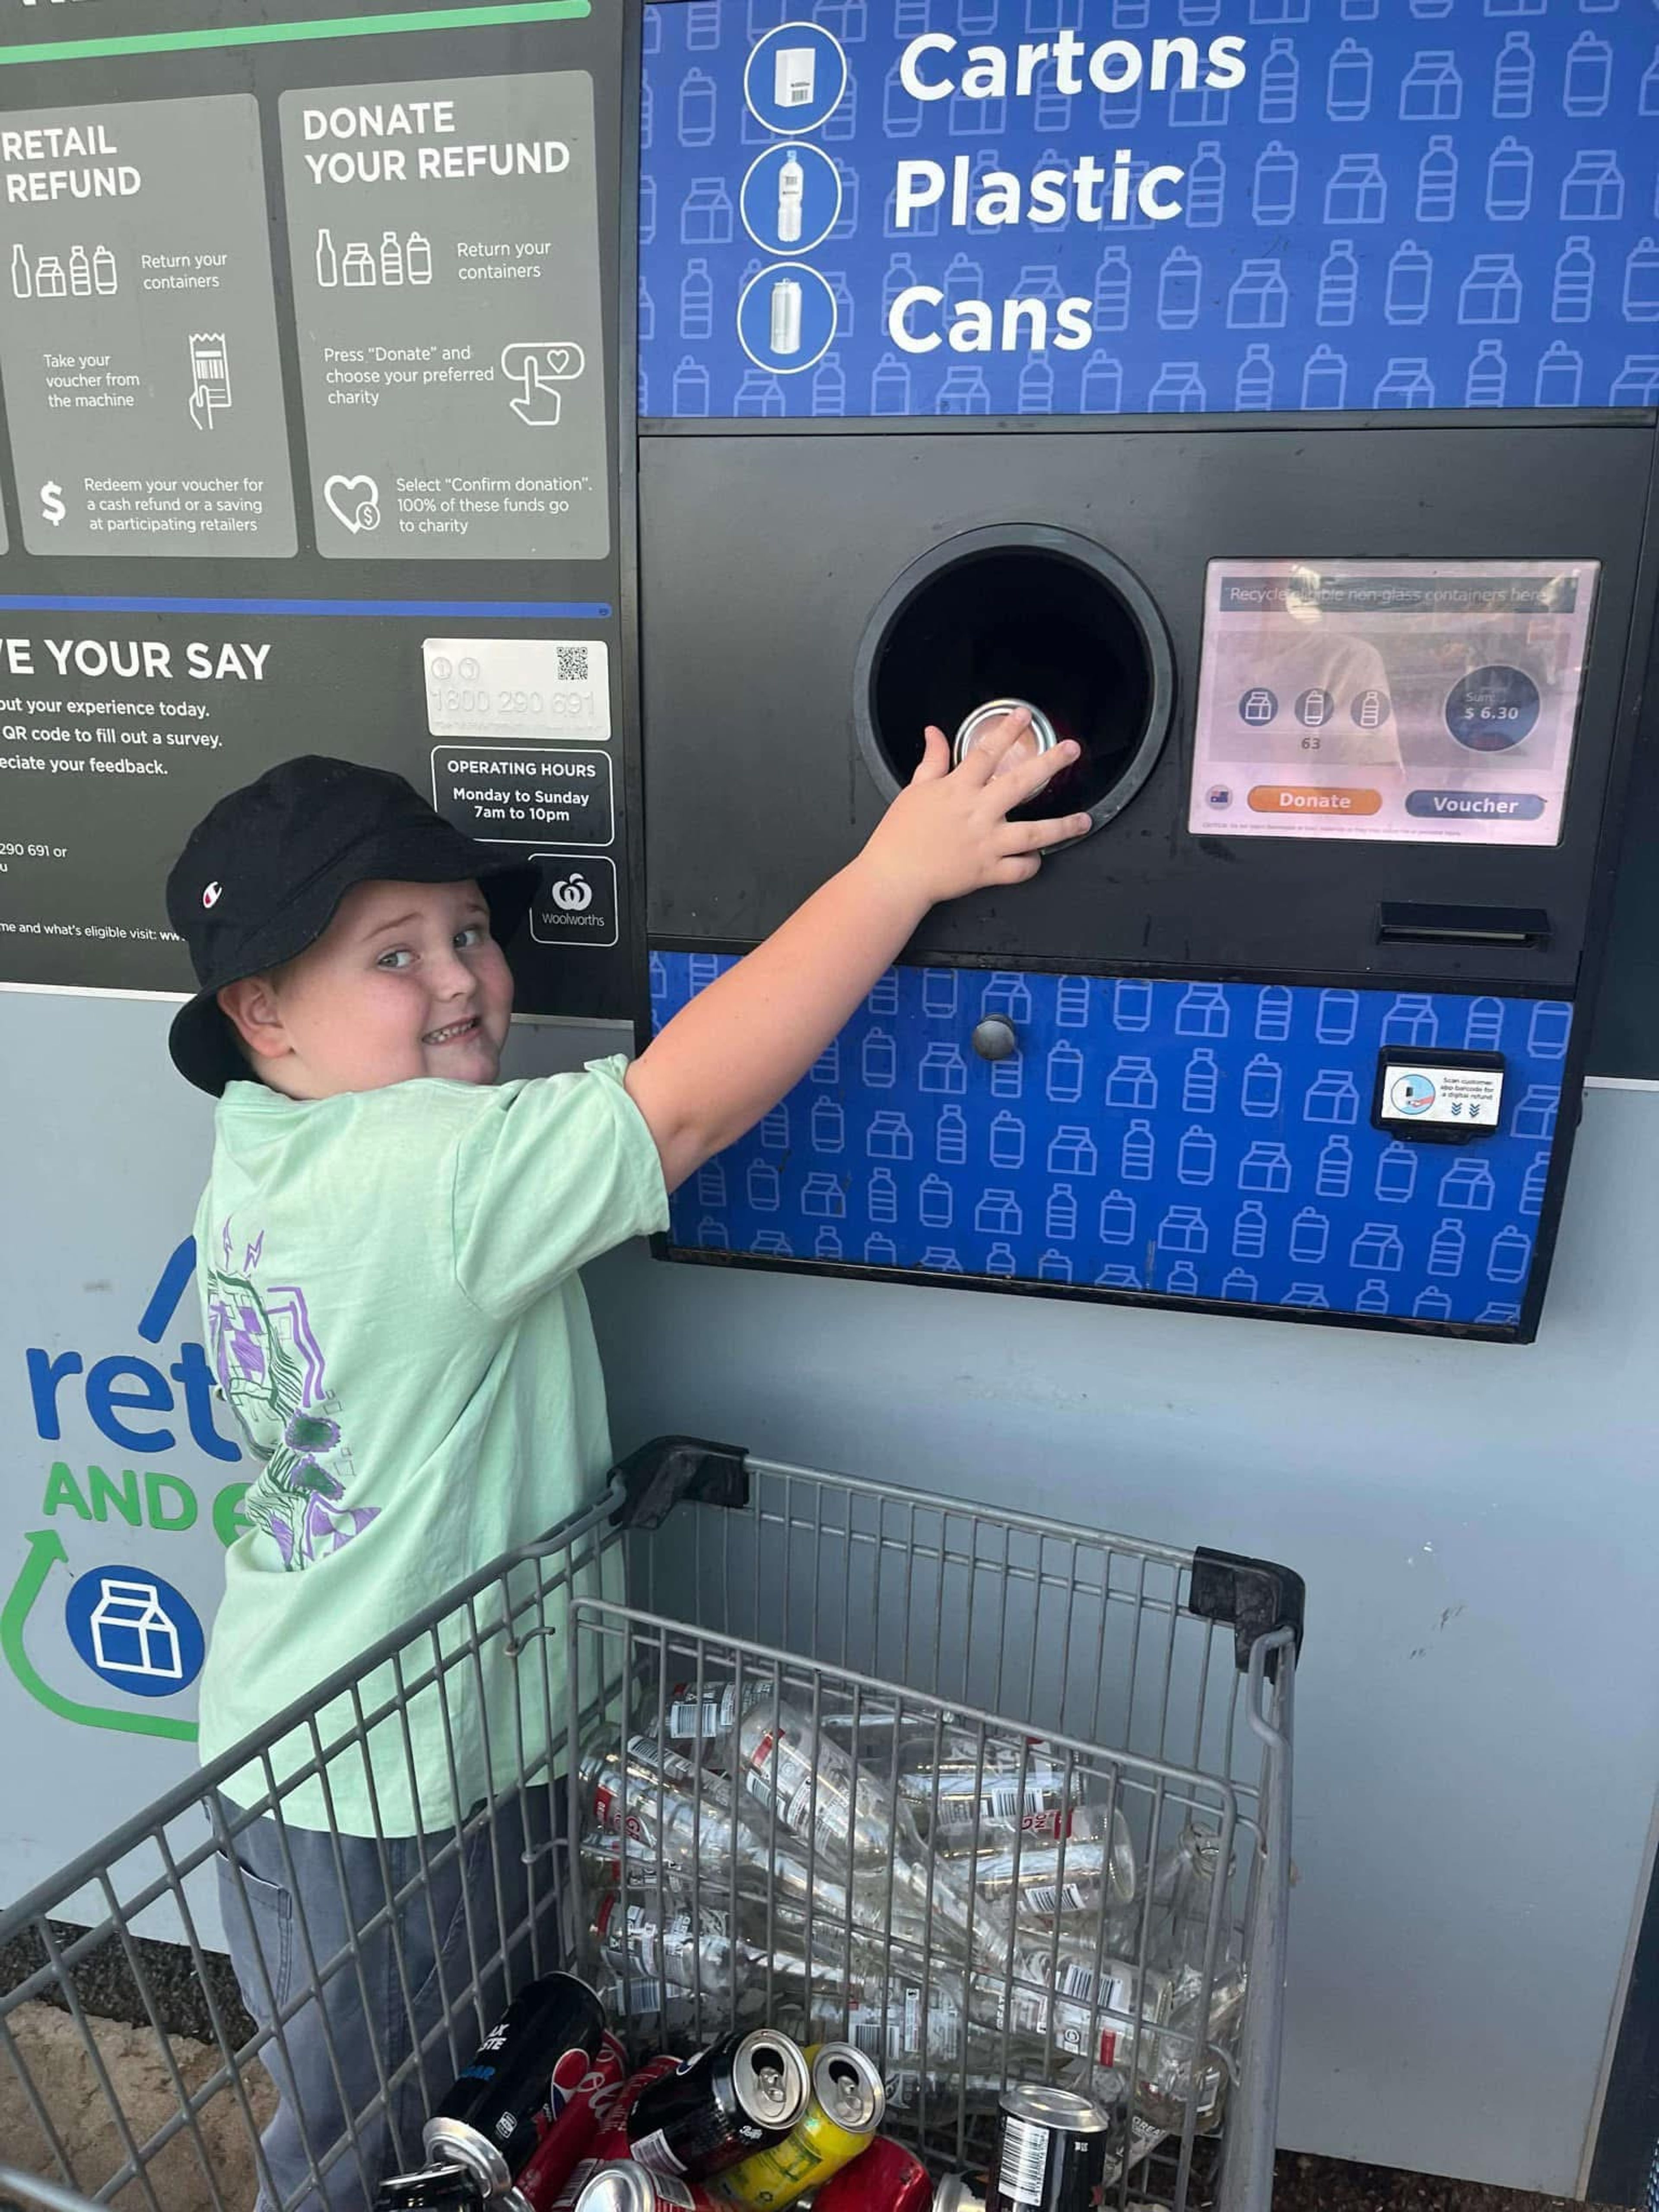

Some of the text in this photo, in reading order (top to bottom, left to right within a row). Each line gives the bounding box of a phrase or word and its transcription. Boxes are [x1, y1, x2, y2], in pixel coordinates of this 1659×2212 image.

[900, 30, 1246, 101] Cartons
[303, 101, 455, 140] DONATE
[2, 125, 117, 161] RETAIL
[305, 141, 569, 184] YOUR REFUND
[6, 166, 141, 203] REFUND
[896, 149, 1185, 227] Plastic
[458, 242, 551, 258] Return your
[141, 254, 227, 269] Return your
[458, 263, 541, 280] containers
[143, 276, 219, 289] containers
[889, 286, 1092, 353] Cans
[43, 354, 110, 369] Take your
[324, 345, 470, 362] Press "Donate" and
[46, 372, 140, 388] voucher from
[326, 366, 494, 385] choose your preferred
[48, 393, 134, 407] the machine
[328, 390, 379, 406] charity
[84, 477, 264, 493] Redeem your voucher for
[397, 477, 592, 492] Select "Confirm donation".
[87, 497, 262, 514] a cash refund or a saving
[397, 497, 569, 514] 100% of these funds go
[89, 517, 257, 533] at participating retailers
[399, 518, 468, 534] to charity
[1230, 587, 1287, 603] Recycle
[1348, 589, 1421, 604] non-glass
[1426, 588, 1505, 601] containers
[0, 639, 270, 680] E YOUR SAY
[0, 698, 210, 719] out your experience today.
[432, 690, 594, 715] 1800 290 691
[1465, 707, 1518, 720] $ 6.30
[3, 725, 222, 749] QR code to fill out a survey.
[1301, 737, 1321, 749] 63
[0, 755, 168, 774] eciate your feedback.
[448, 760, 596, 777] OPERATING HOURS
[454, 788, 589, 807] Monday to Sunday
[1280, 792, 1519, 814] Donate Voucher
[474, 805, 569, 823] 7am to 10pm
[28, 844, 49, 856] 691
[53, 848, 67, 857] or
[542, 913, 605, 926] Woolworths
[0, 923, 16, 932] me
[19, 923, 41, 933] and
[44, 924, 82, 936] what's
[85, 925, 127, 939] eligible
[130, 928, 157, 940] visit:
[26, 1343, 242, 1462] ret
[43, 1462, 198, 1530] AND
